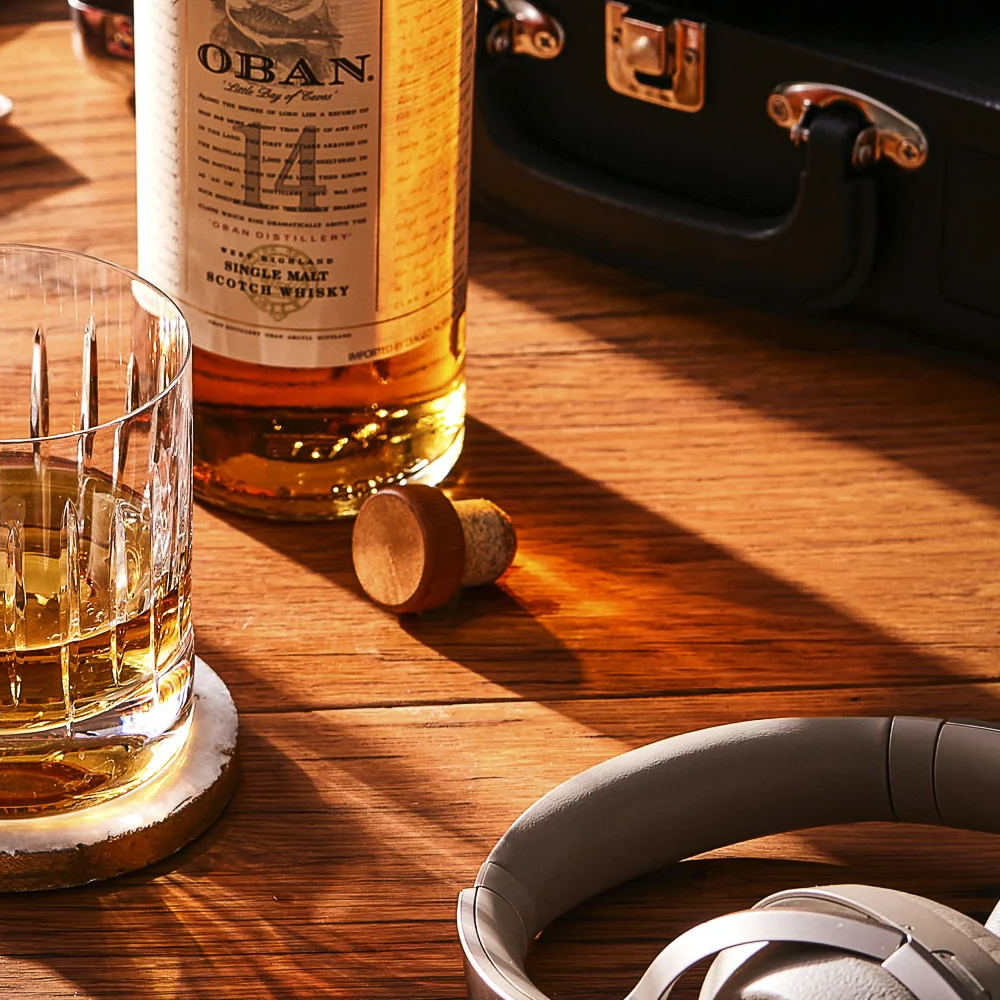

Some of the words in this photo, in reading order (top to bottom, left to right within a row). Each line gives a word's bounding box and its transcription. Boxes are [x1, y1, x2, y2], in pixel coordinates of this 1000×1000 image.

[256, 86, 282, 103] Bay
[284, 89, 303, 104] of
[233, 121, 327, 212] 14
[261, 255, 334, 265] HIGHLAND
[224, 260, 282, 280] SINGLE
[287, 270, 329, 282] MALT
[206, 271, 272, 296] SCOTCH
[280, 285, 350, 298] WHISKY
[348, 344, 392, 361] IMPORTED
